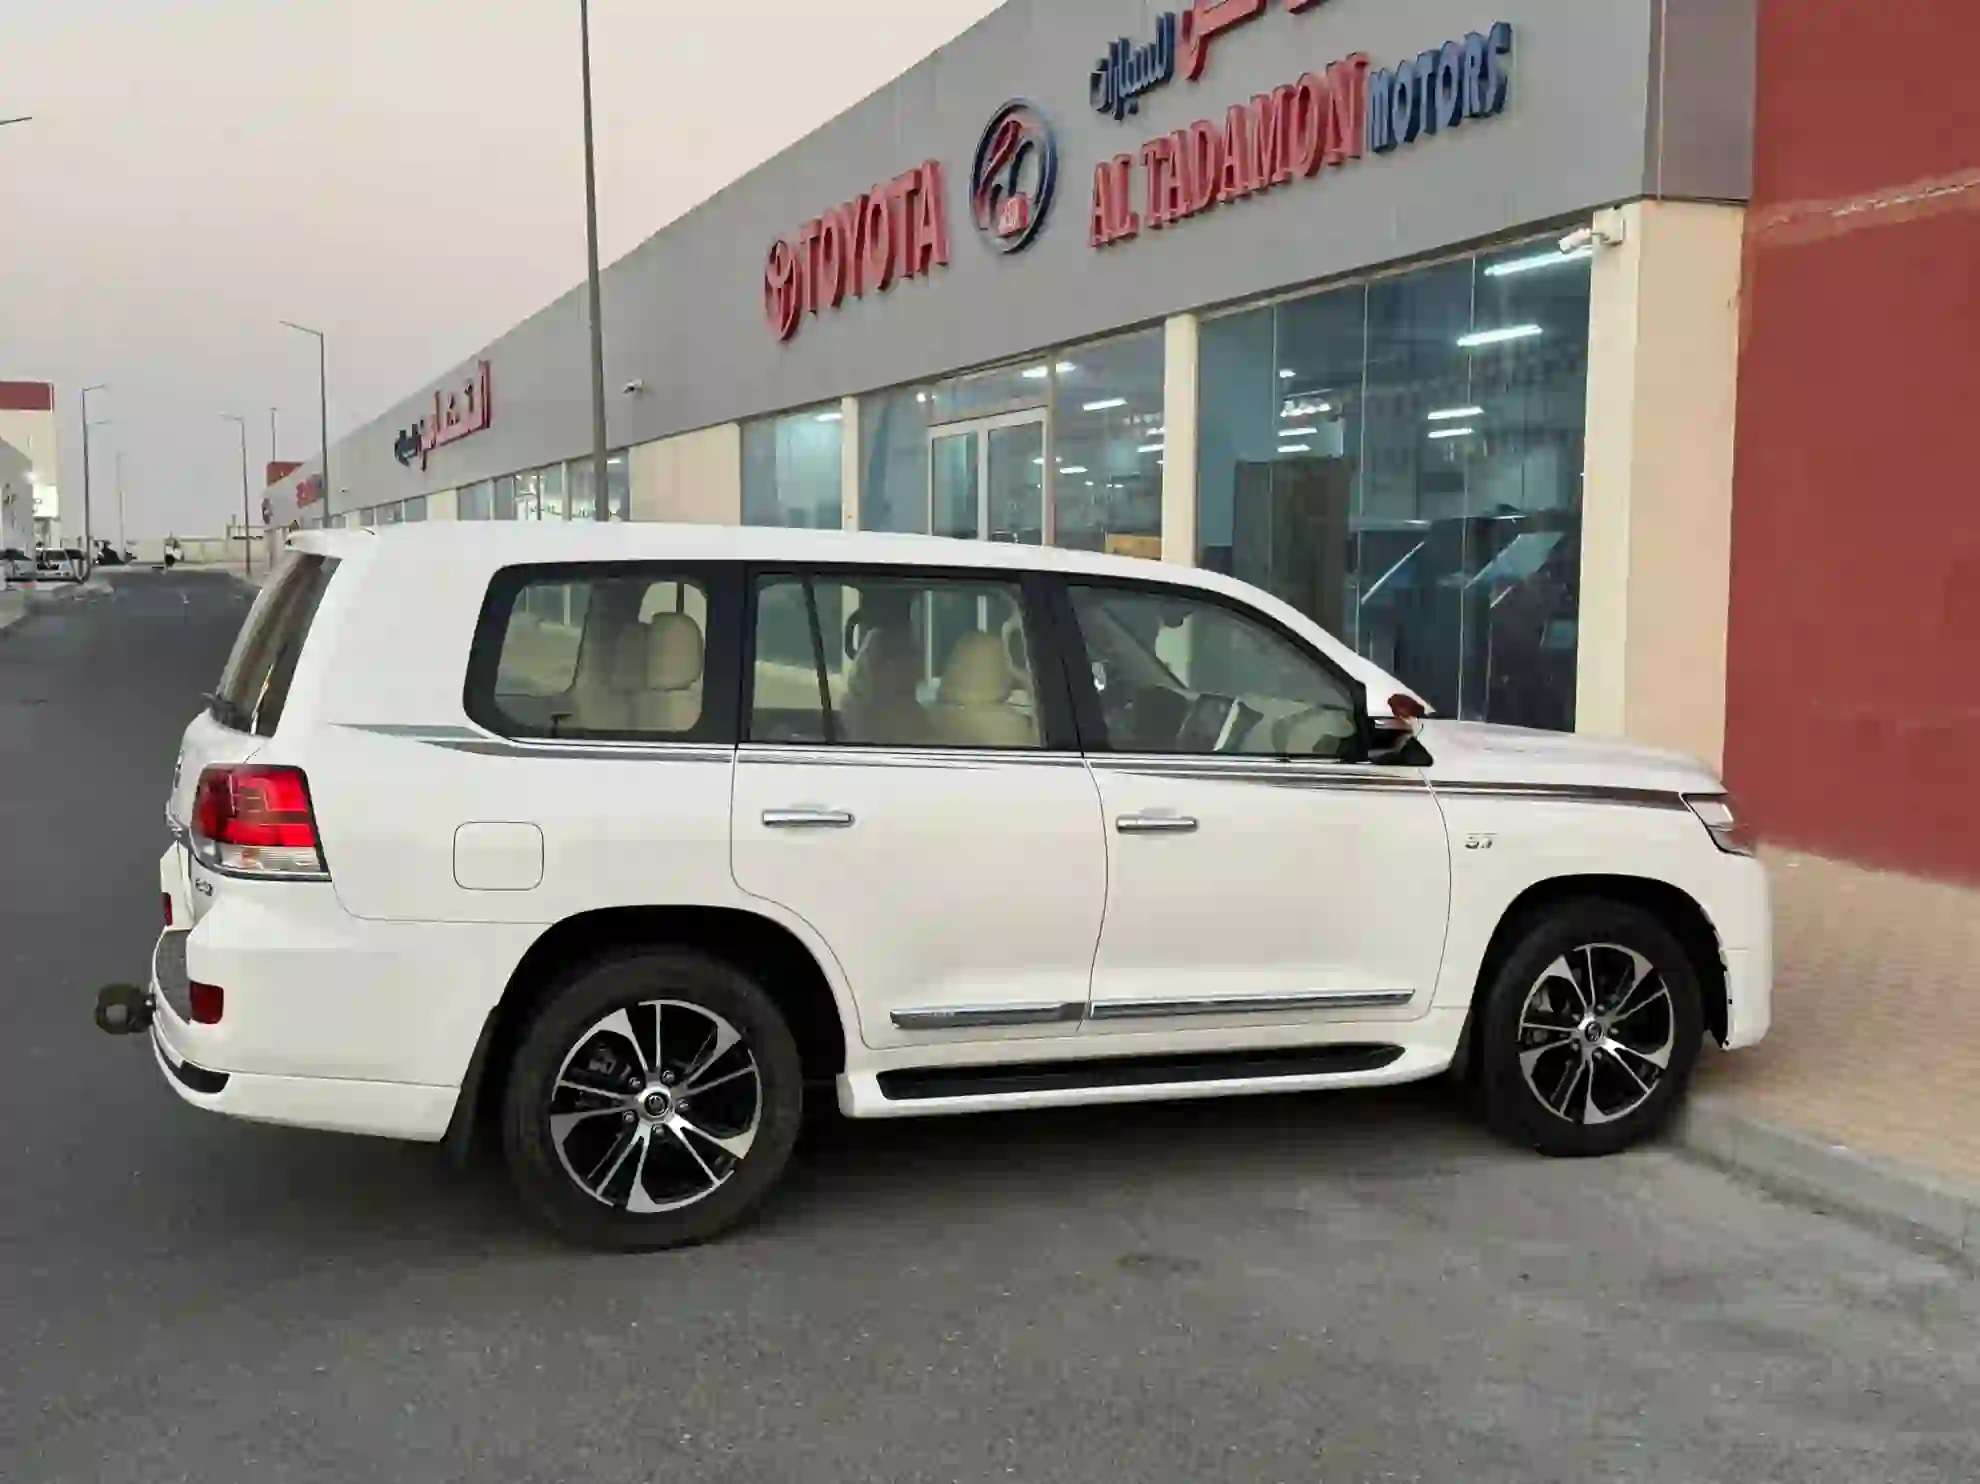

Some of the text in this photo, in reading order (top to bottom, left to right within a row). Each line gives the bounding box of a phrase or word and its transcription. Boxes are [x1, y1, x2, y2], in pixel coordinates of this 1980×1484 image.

[1090, 153, 1140, 248] AL
[1142, 51, 1370, 229] TADAMON
[1369, 21, 1513, 154] MOTORS
[798, 158, 949, 316] TOYOTA
